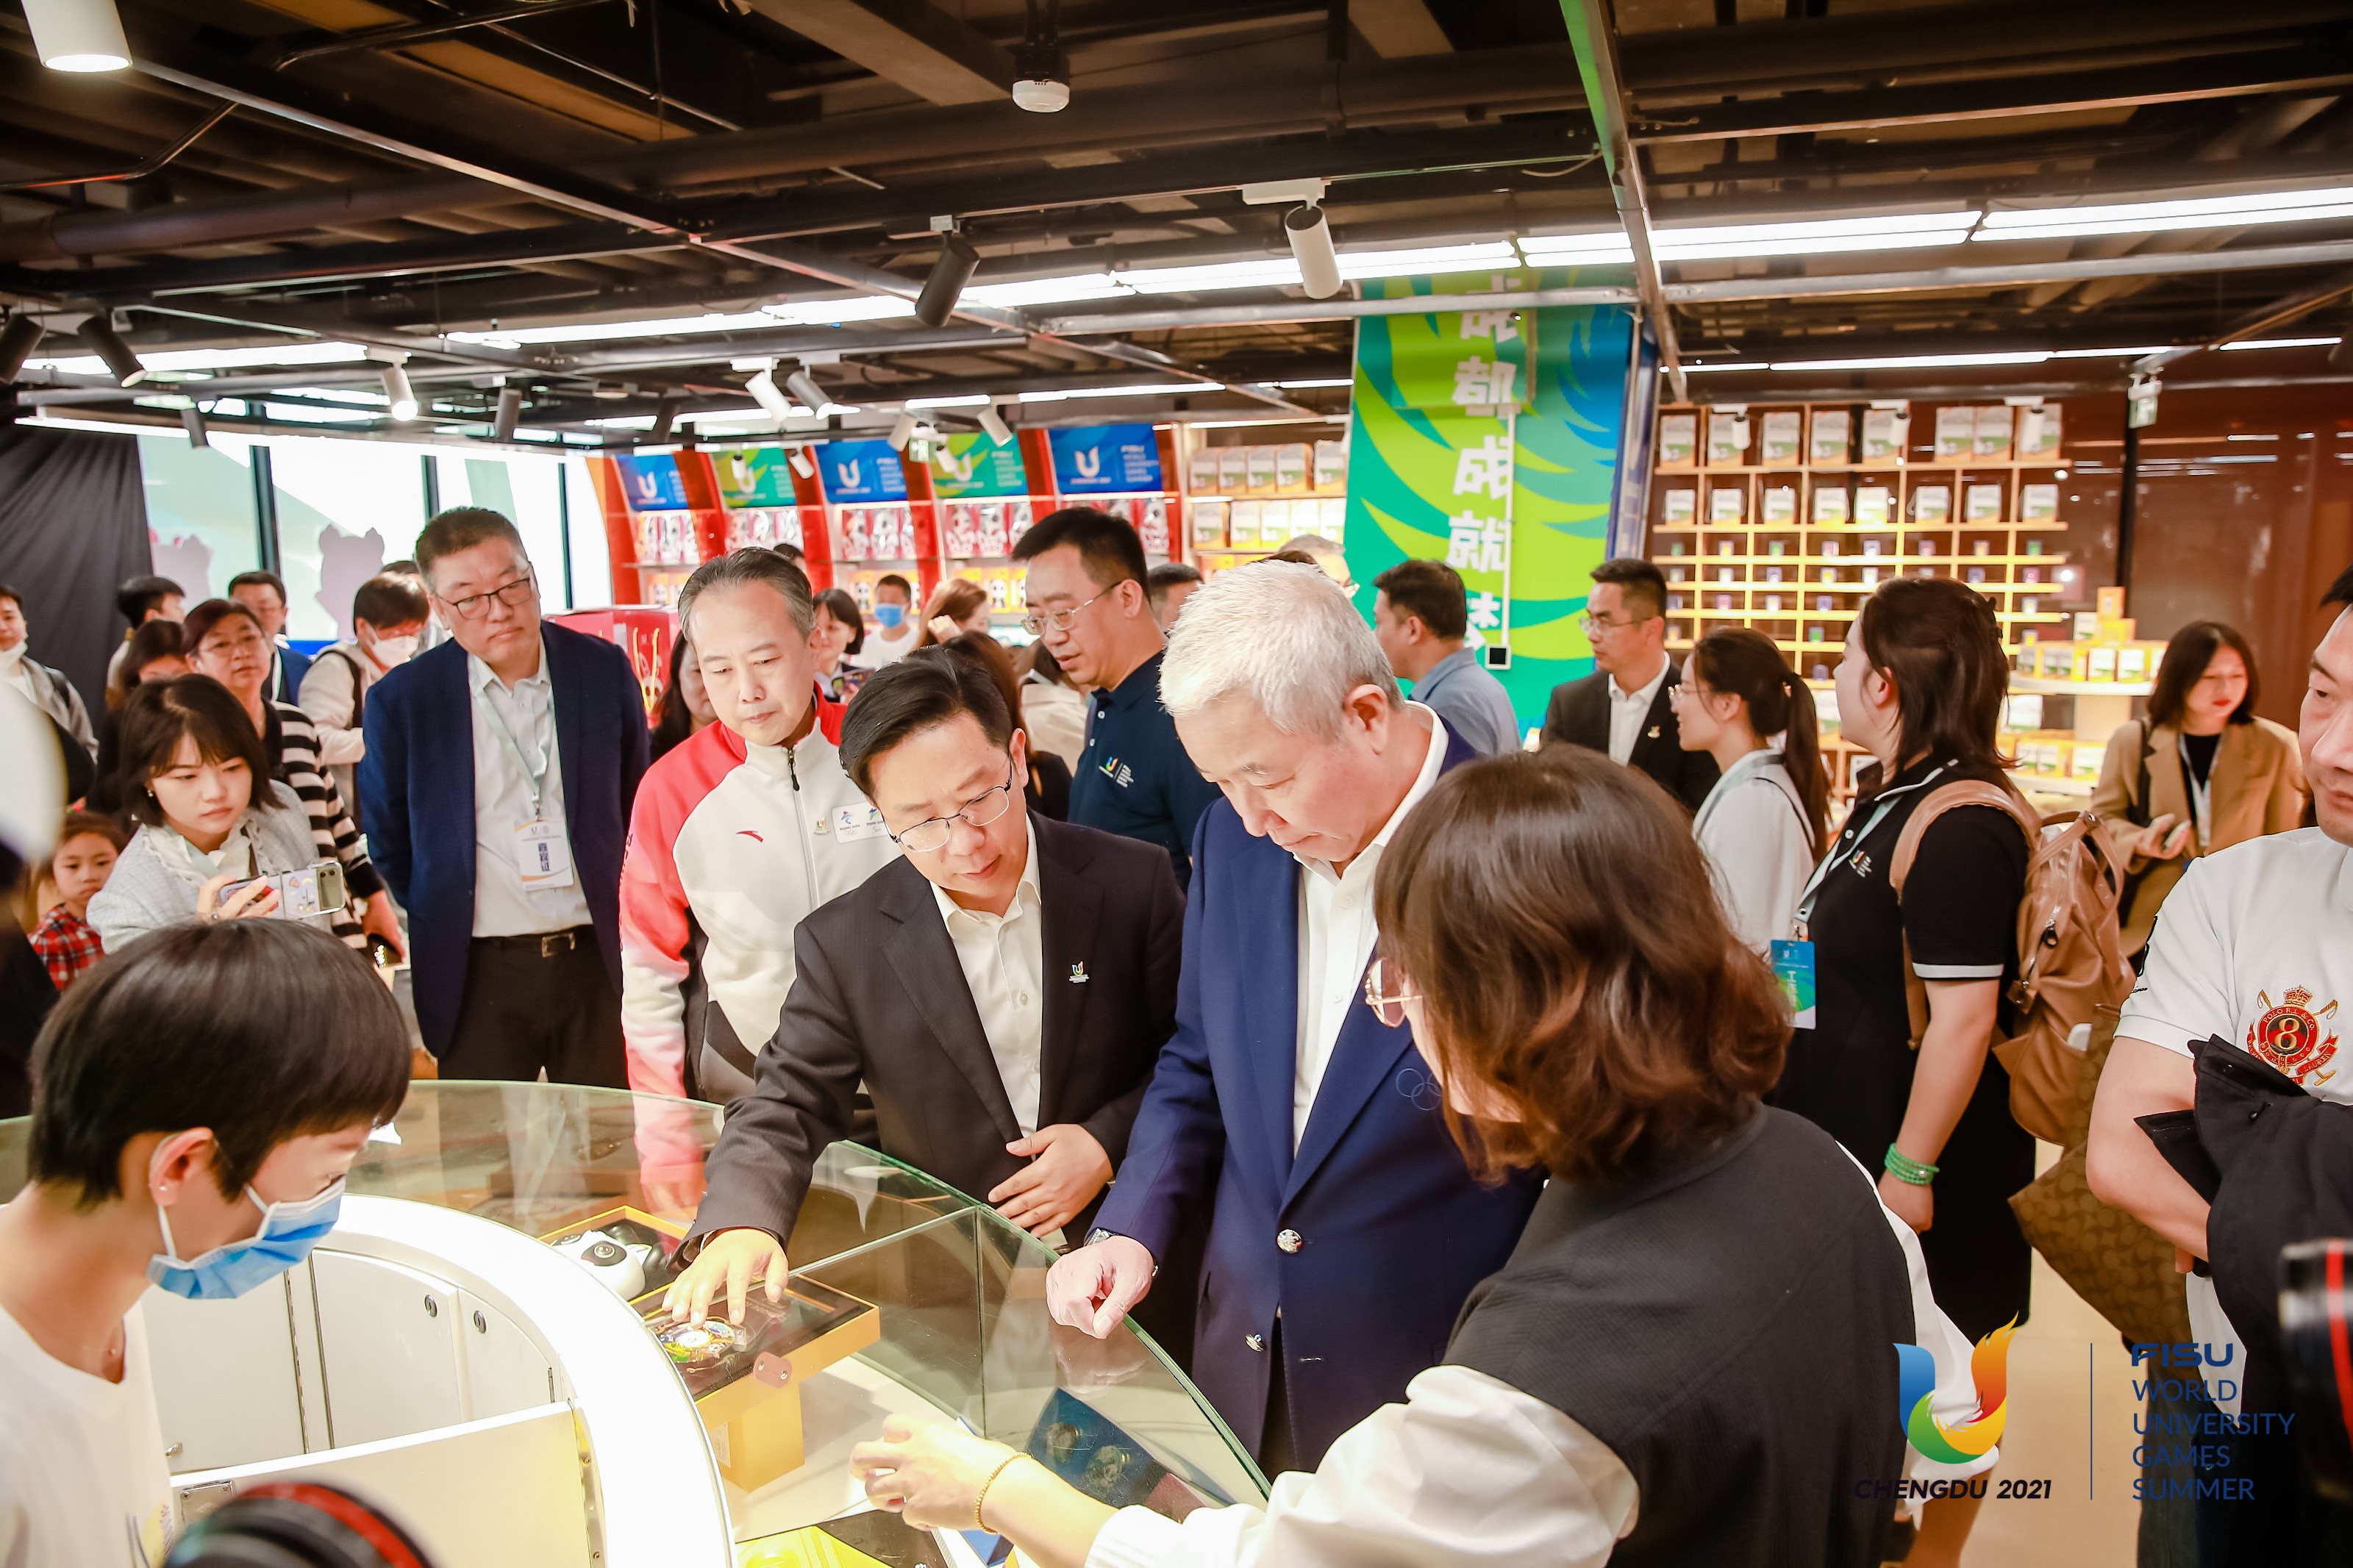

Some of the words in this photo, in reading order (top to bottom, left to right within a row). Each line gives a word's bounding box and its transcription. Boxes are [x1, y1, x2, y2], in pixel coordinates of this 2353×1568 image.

[2263, 1009, 2283, 1023] POLO
[2274, 1018, 2299, 1050] 8
[2304, 1051, 2332, 1072] LAUREN
